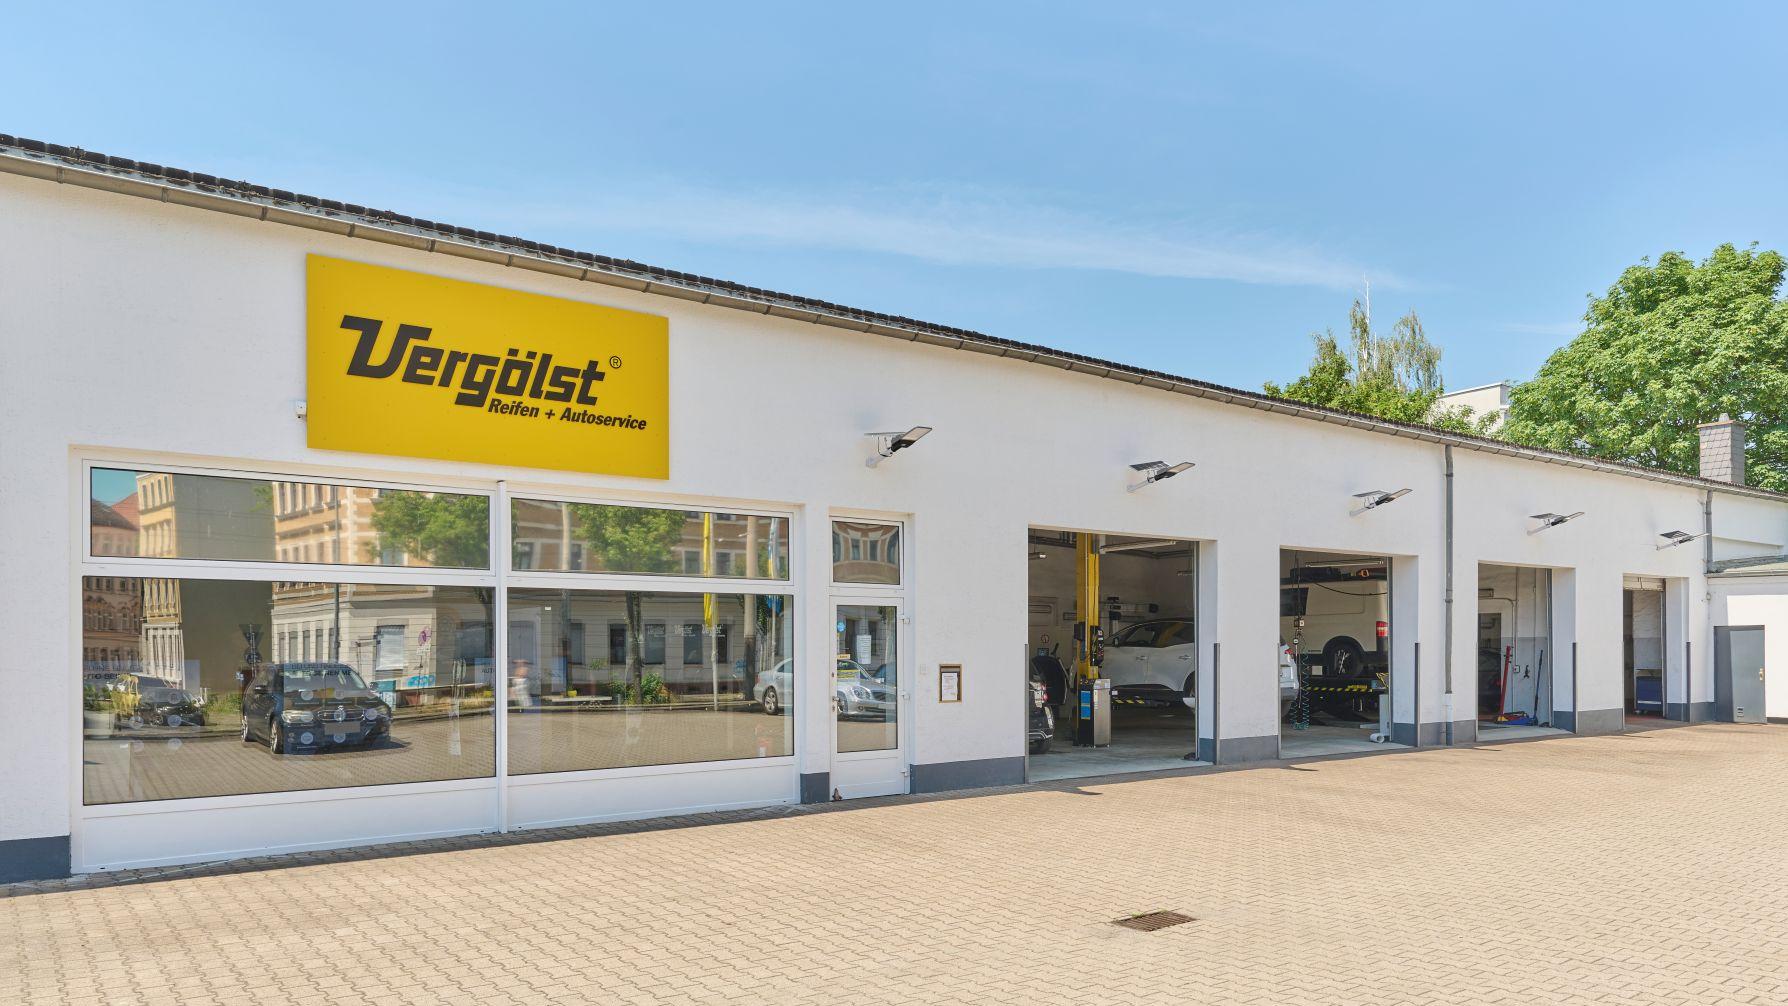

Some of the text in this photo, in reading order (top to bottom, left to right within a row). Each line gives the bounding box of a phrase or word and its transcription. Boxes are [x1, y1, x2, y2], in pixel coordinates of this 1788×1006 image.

[340, 314, 605, 408] Vergölst
[488, 397, 539, 418] Reifen
[560, 407, 647, 430] Autoservice
